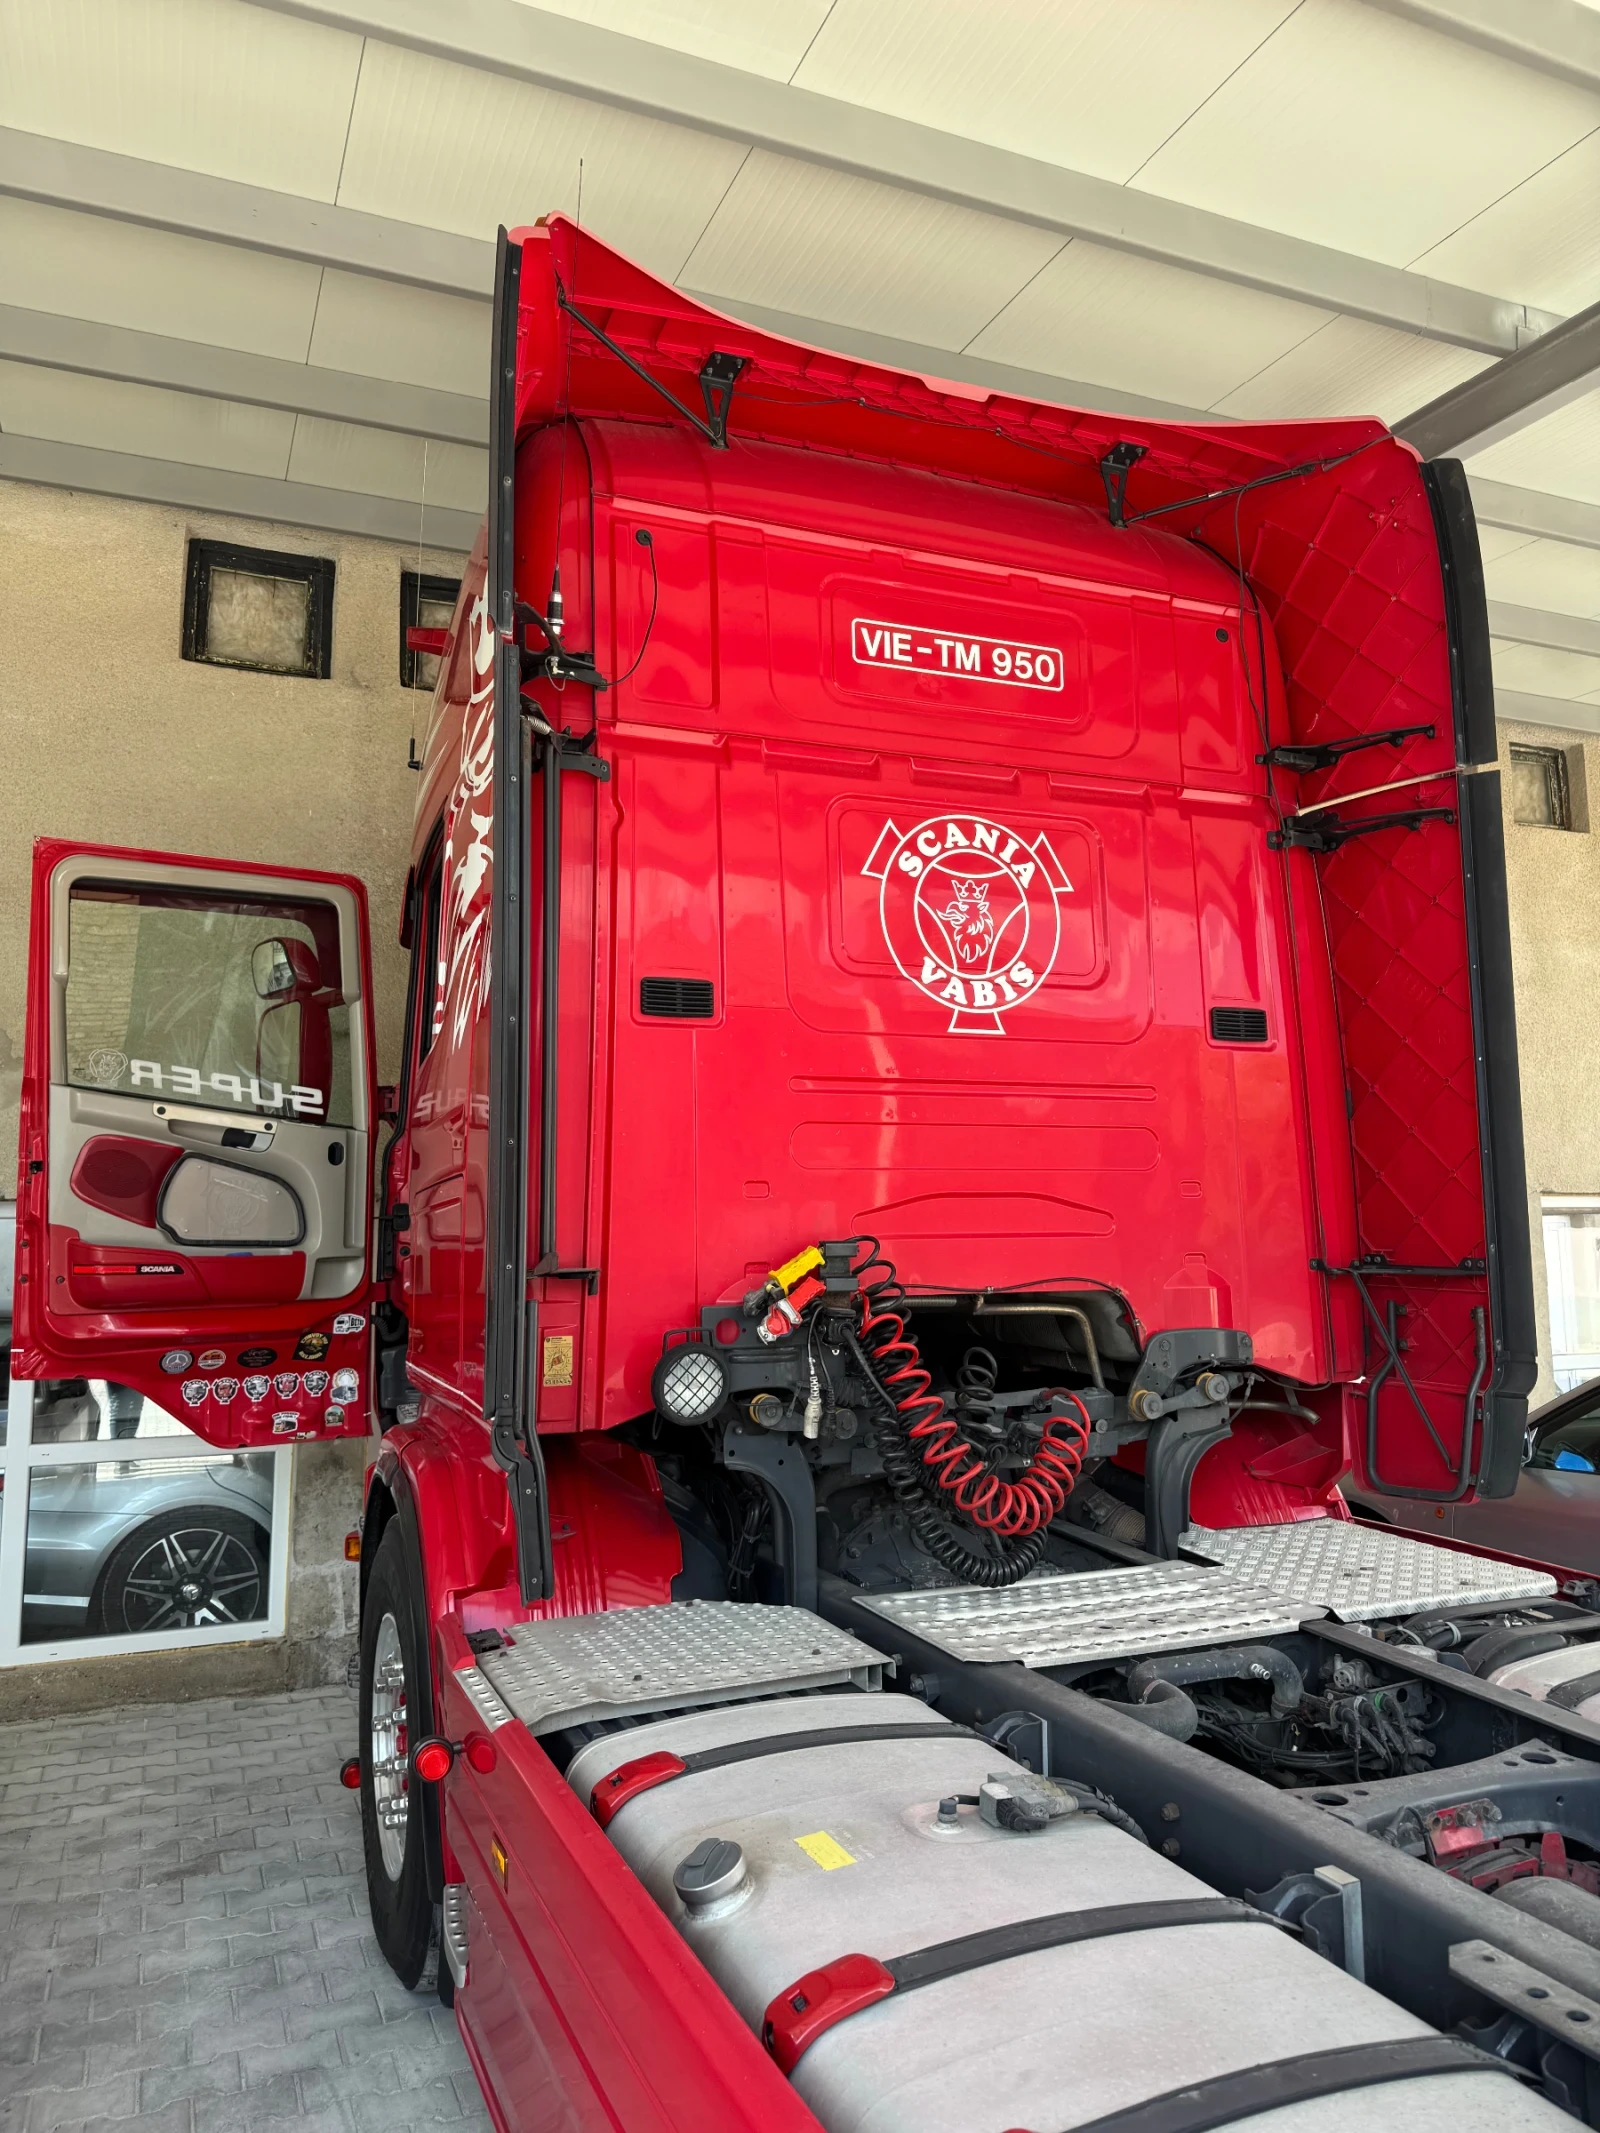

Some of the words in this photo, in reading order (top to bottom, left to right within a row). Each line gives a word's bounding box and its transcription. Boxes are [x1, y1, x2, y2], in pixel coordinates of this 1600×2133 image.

[991, 647, 1056, 683] 950
[898, 822, 1036, 889] SCANIA
[921, 955, 1035, 1007] VABIS
[140, 1265, 175, 1273] SCANIA
